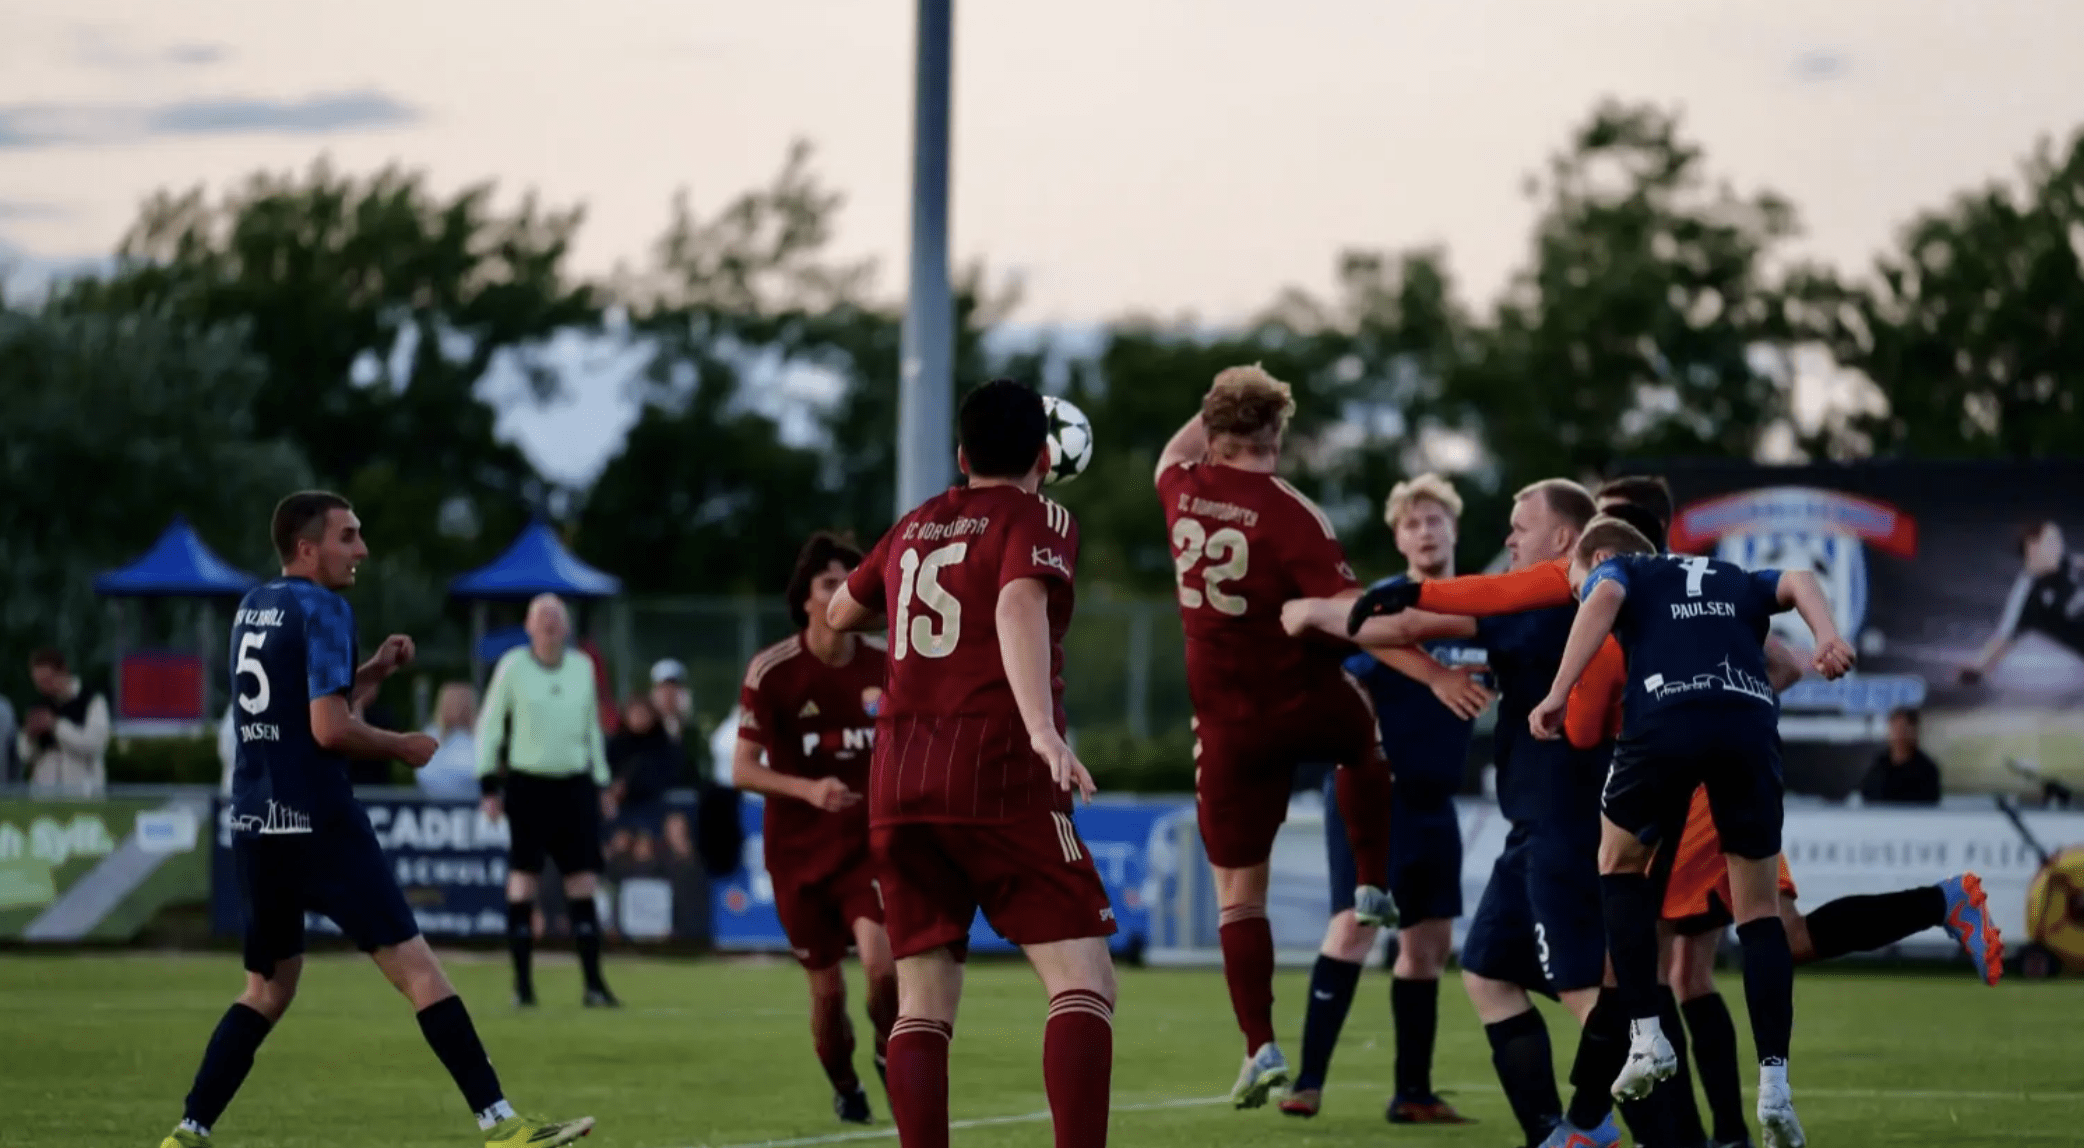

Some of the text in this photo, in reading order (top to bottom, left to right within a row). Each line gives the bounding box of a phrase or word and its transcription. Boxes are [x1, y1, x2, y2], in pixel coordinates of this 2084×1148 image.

[1172, 517, 1249, 617] 22
[1678, 556, 1718, 598] 7
[894, 541, 968, 662] 15
[1671, 601, 1736, 620] PAULSEN
[235, 630, 271, 716] 5
[1535, 923, 1550, 962] 3
